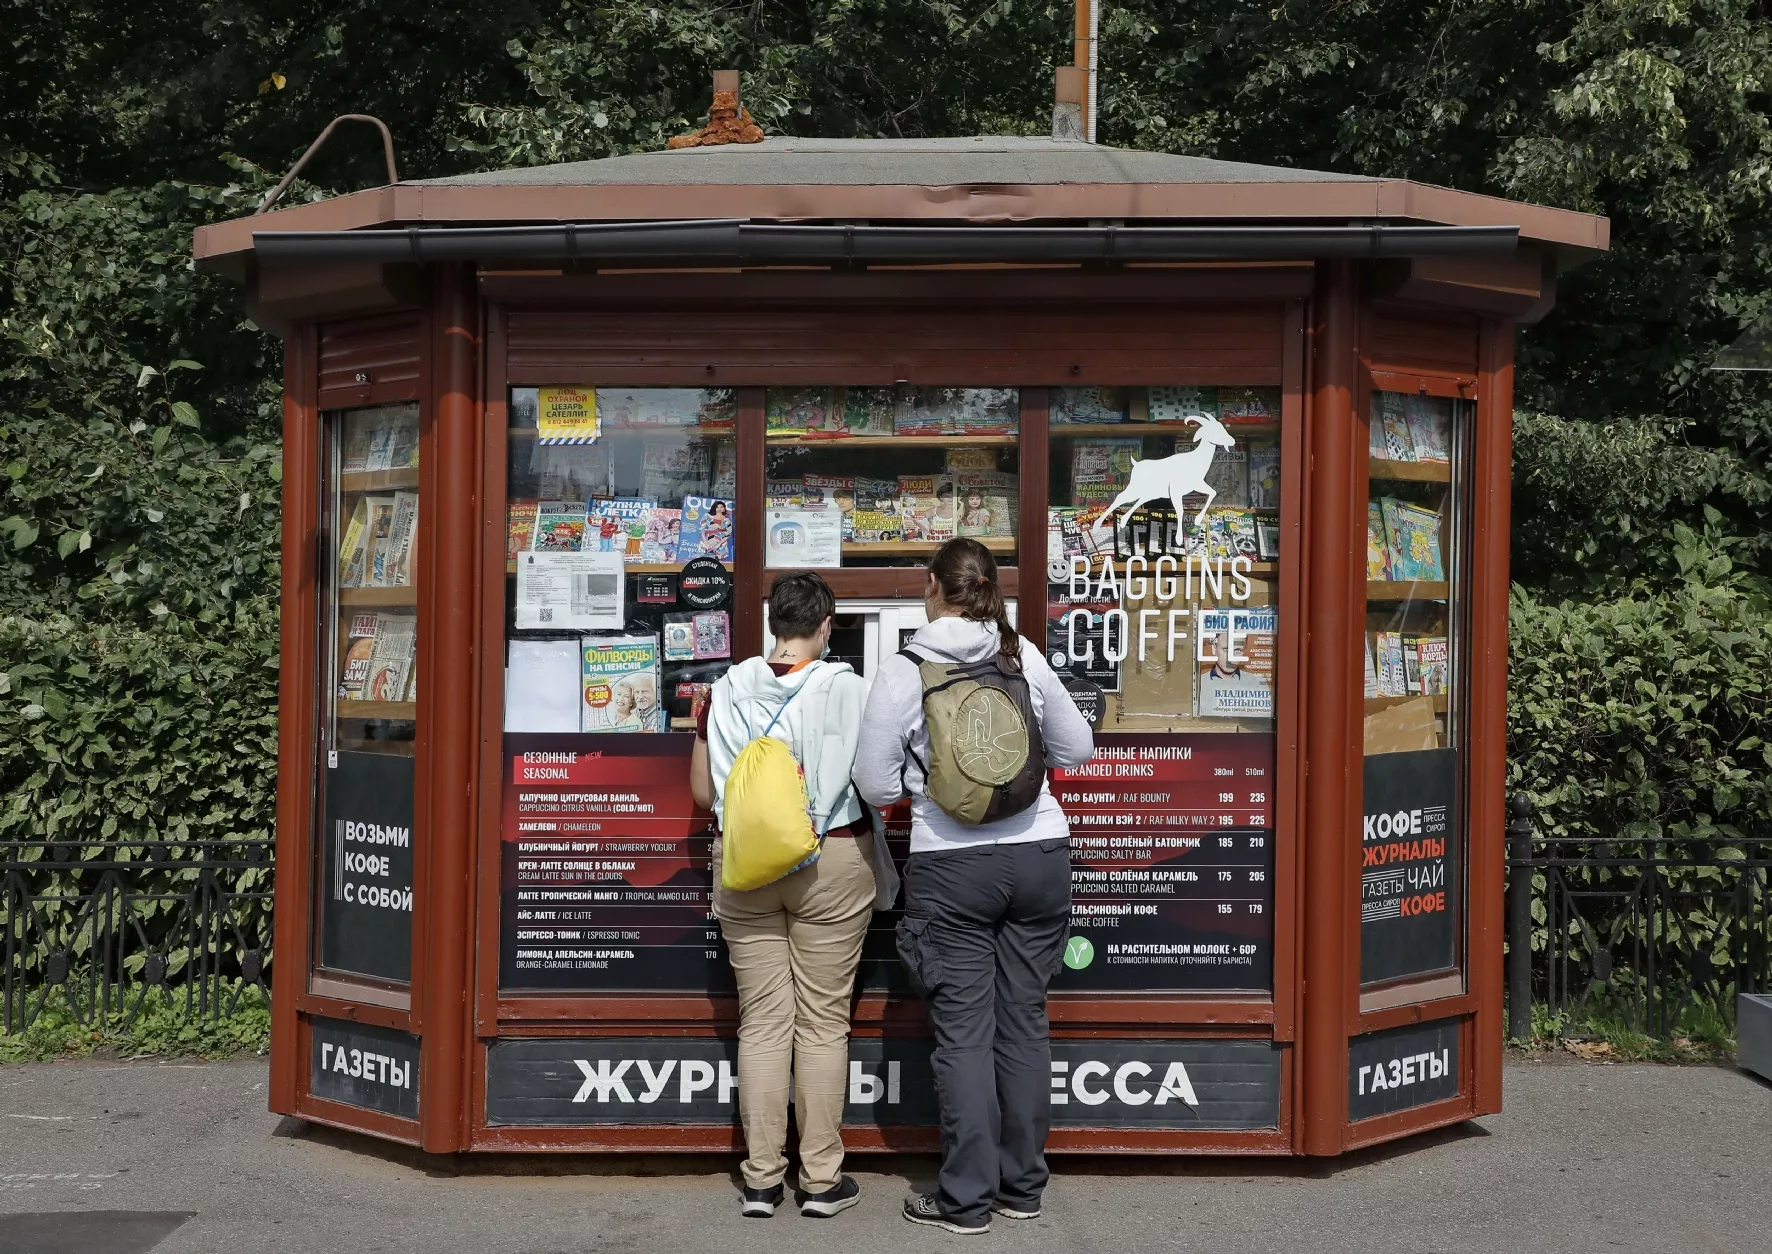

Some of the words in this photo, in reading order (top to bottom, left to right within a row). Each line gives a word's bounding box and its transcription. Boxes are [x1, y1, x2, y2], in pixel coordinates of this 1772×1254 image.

[558, 388, 576, 396] ПОД
[548, 394, 588, 403] ОХРАНОЙ
[551, 403, 583, 411] ЦЕЗАРЬ
[902, 480, 932, 490] ЛЮДИ
[1076, 491, 1109, 499] ЧУДЕСА
[692, 560, 718, 569] СТУДЕНТАМ
[685, 577, 710, 586] СКИДКА
[711, 577, 726, 585] 10%
[1069, 556, 1252, 600] BAGGINS
[1204, 615, 1275, 630] БИОРАФИЯ
[1068, 608, 1250, 662] COFFEE
[1422, 642, 1447, 653] КЛЮЧ
[1421, 651, 1448, 662] ВОРДЫ
[589, 664, 604, 672] НА
[604, 662, 641, 672] ПЕНСИИ
[1214, 689, 1271, 698] ВЛАДИМИР
[1218, 699, 1271, 707] МЕНЬШОВ
[523, 752, 577, 764] СЕЗОННЫЕ
[584, 750, 603, 762] NEW
[1091, 747, 1136, 760] МЕННЫЕ
[1139, 747, 1192, 760] НАПИТКИ
[523, 767, 569, 779] SEASONAL
[1064, 764, 1113, 777] BRANDED
[1115, 764, 1154, 777] DRINKS
[1213, 767, 1234, 777] 380ml
[1245, 767, 1265, 776] 510ml
[519, 794, 558, 803] КАПУЧИНО
[560, 794, 608, 803] ЦИТРУСОВАЯ
[610, 794, 640, 802] ВАНИЛЬ
[1062, 793, 1081, 803] РАФ
[1082, 793, 1116, 803] БАУНТИ
[1123, 793, 1138, 803] RAF
[1140, 793, 1171, 803] BOUNTY
[1218, 793, 1234, 803] 199
[1250, 793, 1265, 803] 235
[519, 804, 560, 812] CAPPUCCINO
[561, 804, 585, 812] CITRUS
[586, 804, 612, 812] VANILLA
[613, 803, 654, 813] (COLD/HOT)
[1065, 816, 1081, 825] АФ
[1082, 816, 1114, 825] МИЛКИ
[1116, 814, 1133, 825] ВЭЙ
[1135, 816, 1141, 825] 2
[1149, 816, 1164, 825] RAF
[1166, 816, 1189, 825] MILKY
[1191, 816, 1208, 825] WAY
[1209, 816, 1215, 825] 2
[1218, 816, 1234, 825] 195
[1249, 816, 1265, 825] 225
[1423, 813, 1446, 823] ПРЕССА
[518, 823, 557, 831] ХАМЕЛЕОН
[563, 823, 601, 831] CHAMELEON
[1363, 809, 1422, 840] КОФЕ
[1426, 823, 1446, 833] СИРОП
[345, 820, 409, 848] ВОЗЬМИ
[518, 842, 570, 852] КЛУБНИЧНЫЙ
[571, 841, 599, 852] ЙОГУРТ
[605, 843, 649, 852] STRAWBERRY
[650, 843, 676, 852] YOGURT
[1109, 836, 1153, 848] СОЛЁНЫЙ
[1155, 838, 1201, 848] БАТОНЧИК
[1218, 837, 1233, 847] 185
[1249, 837, 1264, 847] 210
[1111, 850, 1134, 860] SALTY
[1135, 850, 1152, 860] BAR
[1362, 837, 1445, 867] ЖУРНАЛЫ
[344, 852, 390, 877] КОФЕ
[518, 861, 562, 871] КРЕМ-ЛАТТЕ
[563, 861, 593, 871] СОЛНЦЕ
[595, 861, 601, 870] В
[601, 861, 636, 871] ОБЛАКАХ
[518, 872, 540, 880] CREAM
[541, 872, 559, 880] LATTE
[560, 872, 574, 880] SUN
[576, 872, 582, 880] IN
[584, 872, 596, 880] THE
[597, 872, 623, 880] CLOUDS
[1071, 871, 1108, 882] ПУЧИНО
[1109, 869, 1150, 882] СОЛЁНАЯ
[1152, 871, 1198, 882] КАРАМЕЛЬ
[1217, 871, 1232, 881] 175
[1249, 871, 1265, 881] 205
[1362, 878, 1404, 898] ГАЗЕТЫ
[1408, 859, 1444, 890] ЧАЙ
[1070, 883, 1109, 894] PPUCCINO
[1110, 883, 1138, 894] SALTED
[1140, 883, 1176, 894] CARAMEL
[343, 883, 354, 902] С
[357, 885, 413, 912] СОБОЙ
[517, 892, 539, 900] ЛАТТЕ
[540, 890, 592, 900] ТРОПИЧЕСКИЙ
[593, 892, 619, 900] МАНГО
[625, 892, 656, 901] TROPICAL
[657, 892, 680, 901] MANGO
[681, 892, 700, 901] LATTE
[1071, 903, 1132, 915] ЕЛЬСИНОВЫЙ
[1133, 905, 1158, 915] КОФЕ
[1217, 904, 1232, 914] 155
[1248, 904, 1263, 914] 179
[1362, 901, 1382, 911] ПРЕССА
[1382, 897, 1401, 908] СИРОП
[1400, 892, 1445, 917] КОФЕ
[517, 910, 556, 920] АЙС-ЛАТТЕ
[562, 912, 572, 920] ICE
[573, 912, 592, 920] LATTE
[1092, 917, 1120, 927] COFFEE
[516, 931, 581, 940] ЭСПРЕССО-ТОНИК
[587, 931, 620, 940] ESPRESSO
[621, 931, 640, 940] TONIC
[705, 931, 717, 940] 175
[1107, 944, 1120, 954] НА
[1121, 944, 1191, 954] РАСТИТЕЛЬНОМ
[1193, 944, 1230, 954] МОЛОКЕ
[516, 950, 553, 960] ЛИМОНАД
[554, 950, 635, 959] АПЕЛЬСИН-КАРАМЕЛЬ
[705, 951, 717, 959] 170
[1107, 956, 1112, 964] К
[1112, 956, 1149, 964] СТОИМОСТИ
[1150, 956, 1179, 965] НАПИТКА
[1180, 955, 1216, 966] (УТОЧНЯЙТЕ
[1217, 957, 1222, 965] У
[1222, 956, 1252, 965] БАРИСТА)
[516, 960, 574, 969] ORANGE-CARAMEL
[575, 960, 609, 969] LEMONADE
[321, 1043, 410, 1089] ГАЗЕТЫ
[1359, 1048, 1449, 1096] ГАЗЕТЫ
[571, 1059, 901, 1104] ЖУРНЫ
[1050, 1060, 1199, 1106] ЕССА
